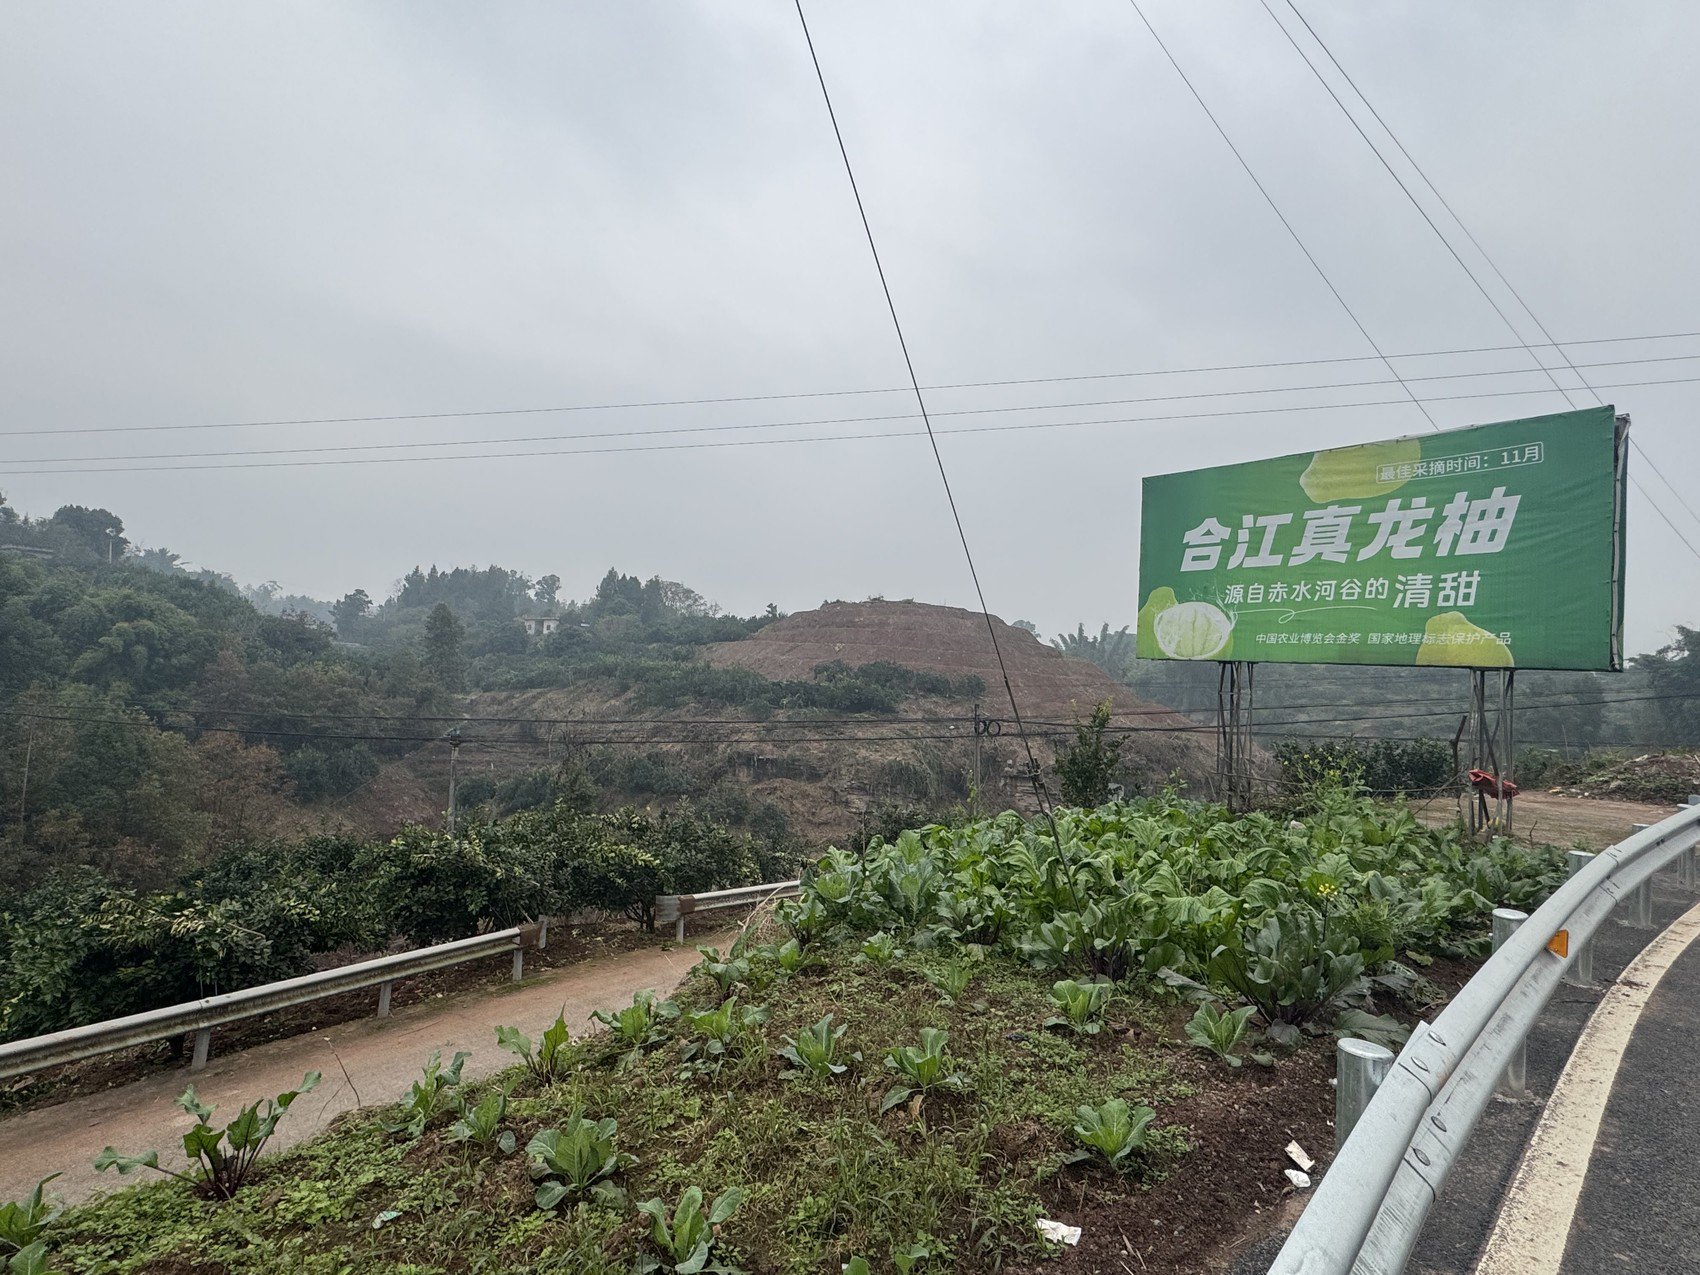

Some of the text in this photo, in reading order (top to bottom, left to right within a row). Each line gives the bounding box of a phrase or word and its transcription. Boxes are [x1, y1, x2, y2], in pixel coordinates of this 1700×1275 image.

[1180, 486, 1522, 572] 合江真龙柚
[1255, 632, 1361, 645] 中国农业博览会金奖
